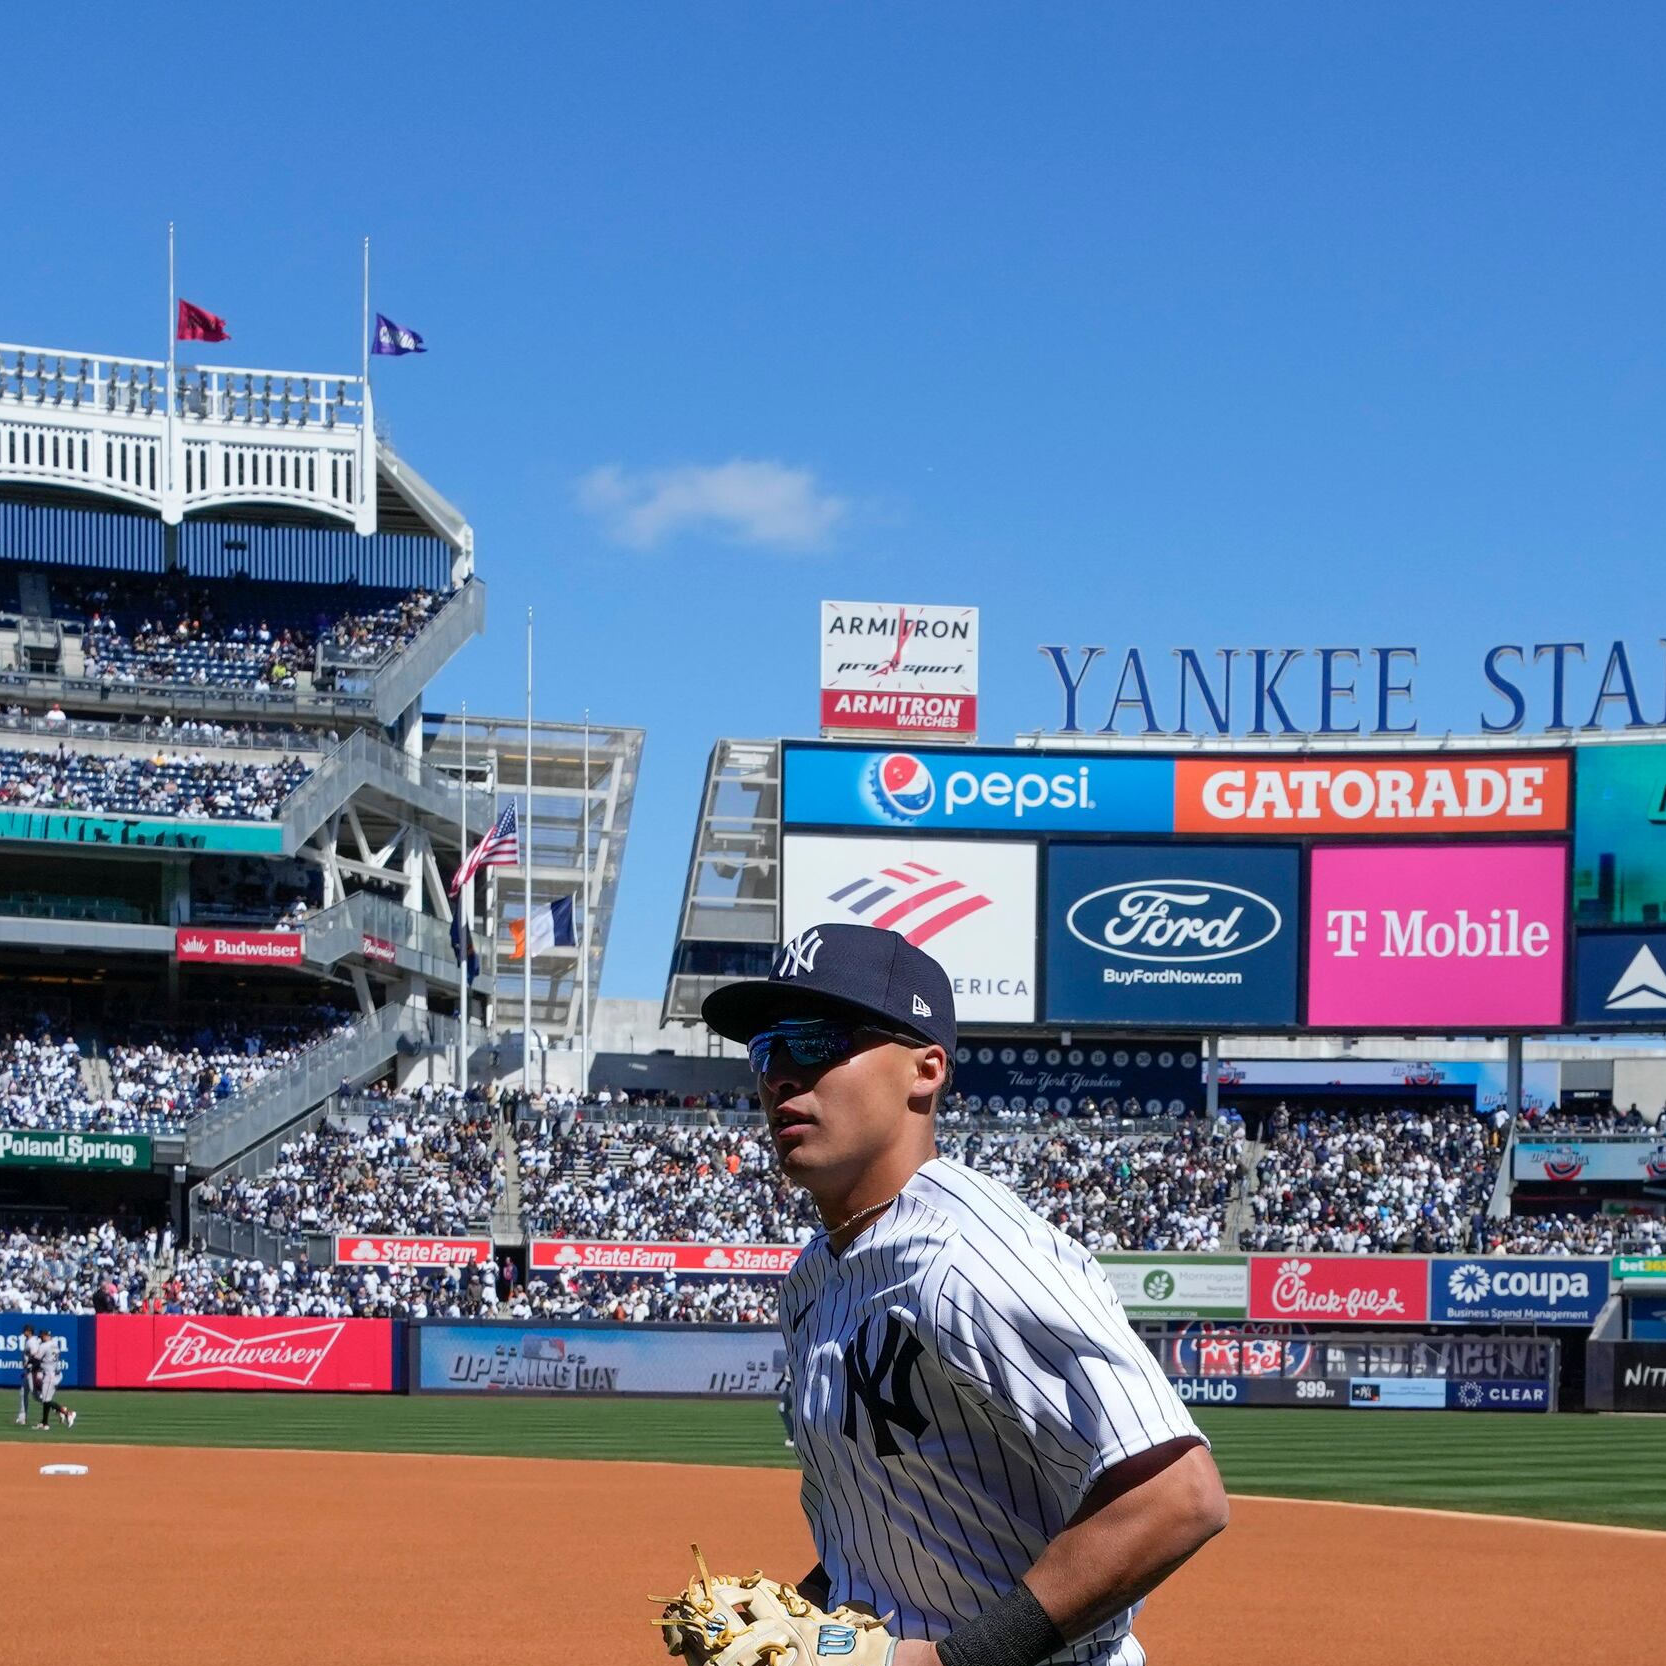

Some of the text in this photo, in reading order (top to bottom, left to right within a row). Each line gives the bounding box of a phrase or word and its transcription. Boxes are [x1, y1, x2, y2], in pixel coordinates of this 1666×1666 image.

[829, 616, 969, 639] ARMITRON
[1039, 645, 1419, 736] YANKEE
[835, 694, 962, 717] ARMITRON
[897, 714, 959, 728] WATCHES
[945, 767, 1089, 816] pepsi
[1202, 767, 1544, 819] GATORADE
[1104, 889, 1242, 950] Ford
[1380, 909, 1550, 959] Mobile
[214, 939, 298, 957] Budweiser
[953, 978, 1029, 996] ERICA
[1104, 968, 1242, 986] BuyFordNow.com
[67, 1136, 135, 1166] Spring
[733, 1250, 799, 1269] StateFa
[1179, 1271, 1245, 1283] Morningside
[1492, 1270, 1589, 1305] coupa
[1272, 1268, 1404, 1318] Chick-fil-A
[1447, 1307, 1589, 1322] Business Spend Management
[167, 1332, 327, 1367] Budweiser
[448, 1352, 621, 1390] OPENING DAY
[1296, 1381, 1325, 1398] 399
[1490, 1387, 1544, 1401] CLEAR
